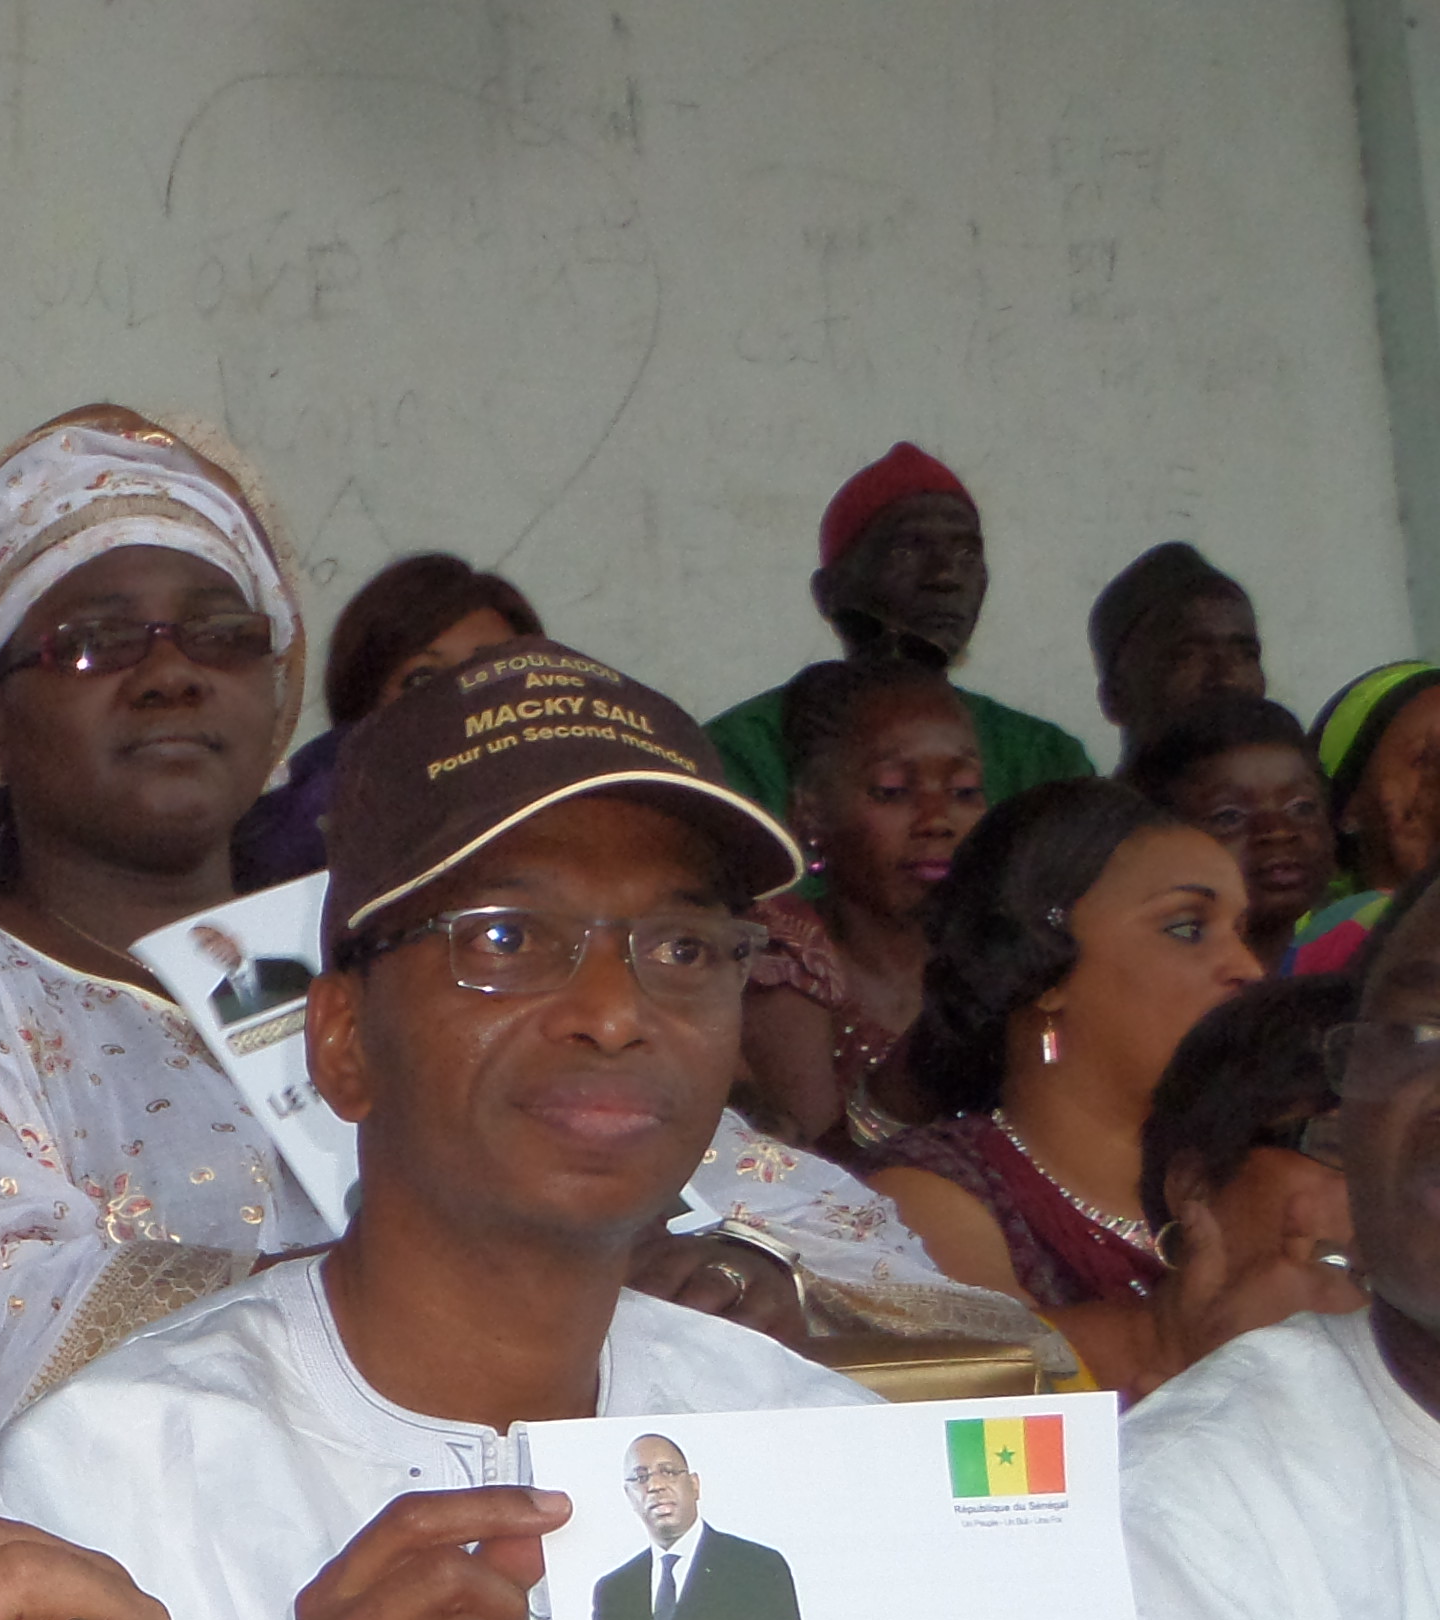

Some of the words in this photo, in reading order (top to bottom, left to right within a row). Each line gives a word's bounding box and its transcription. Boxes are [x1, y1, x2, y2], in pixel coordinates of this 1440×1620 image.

[493, 655, 620, 684] FOULADOU
[524, 671, 586, 689] Avec
[465, 697, 585, 737] MACKY
[592, 699, 655, 734] SALL
[427, 746, 481, 780] Pour
[486, 735, 518, 753] un
[523, 724, 617, 742] Second
